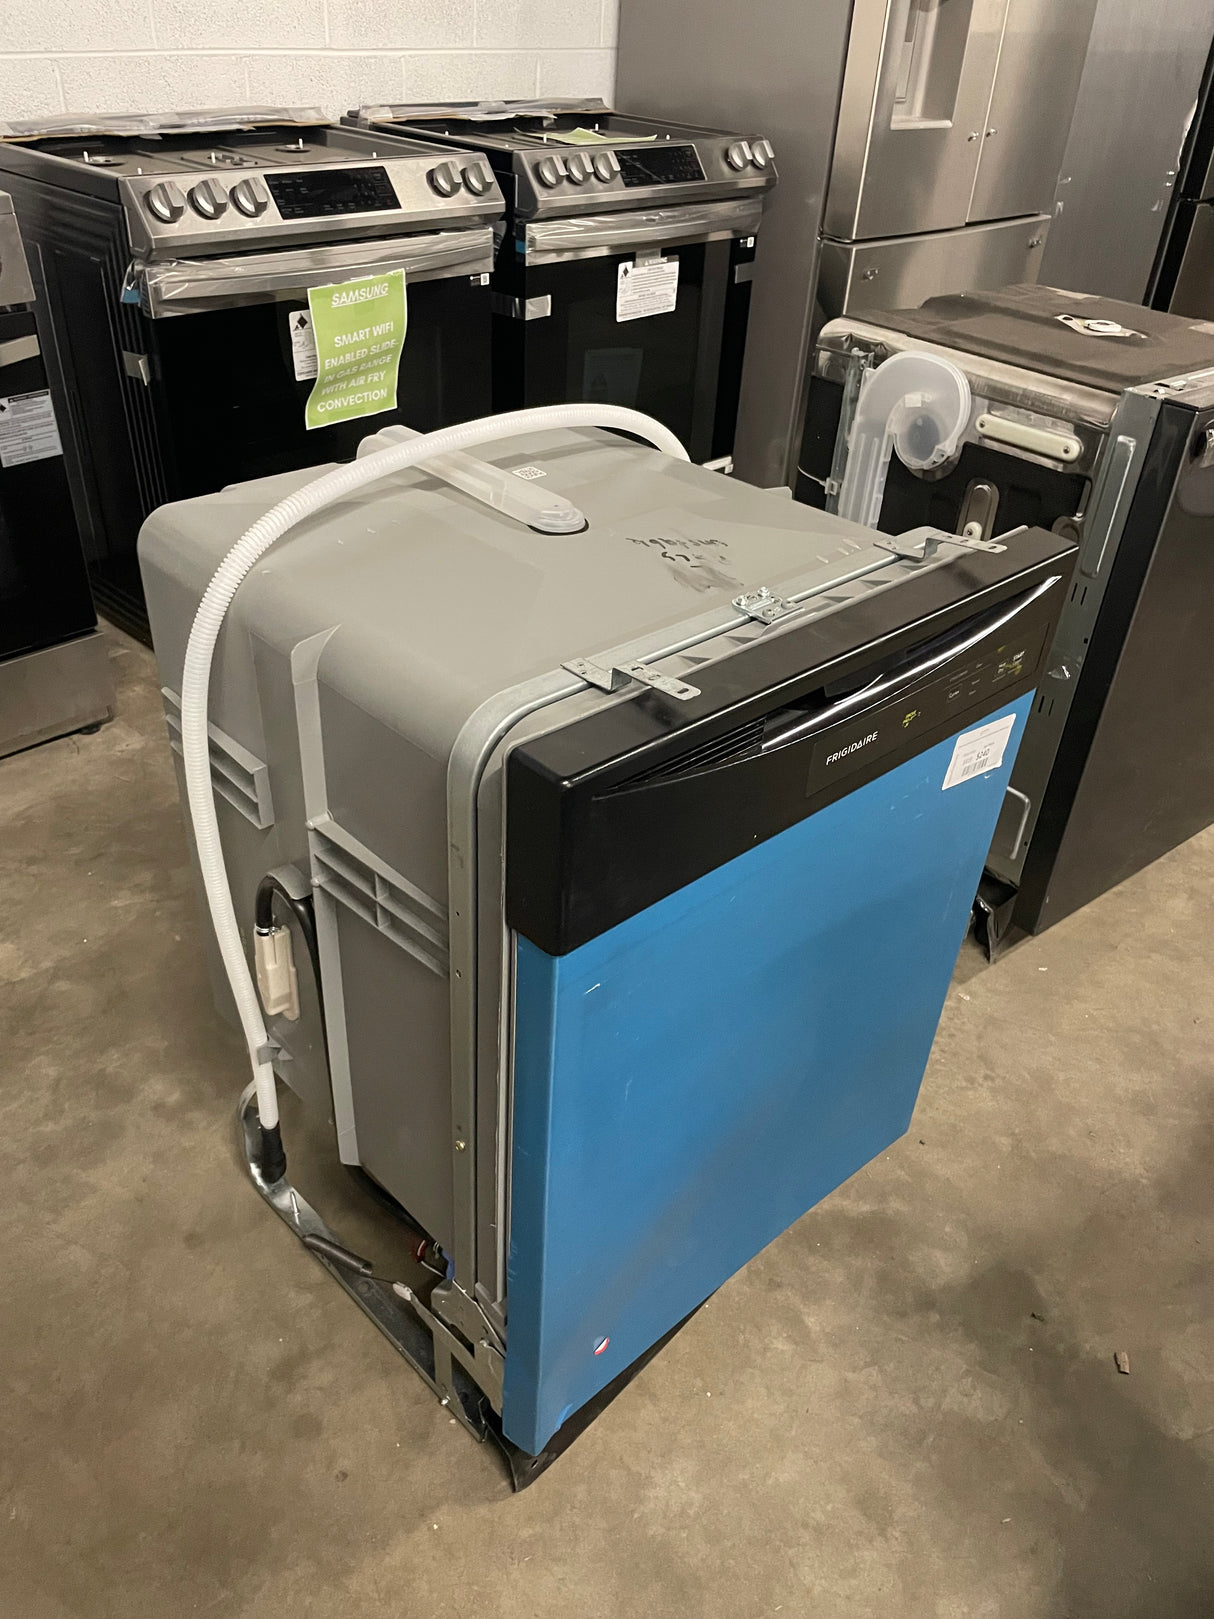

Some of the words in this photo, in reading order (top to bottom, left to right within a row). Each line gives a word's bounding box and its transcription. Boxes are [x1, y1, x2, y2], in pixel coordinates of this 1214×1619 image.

[331, 283, 389, 306] SAMSUNG
[334, 327, 370, 348] SMART
[372, 321, 394, 337] WIFI
[324, 348, 368, 370] ENABLED
[369, 339, 399, 355] SLIDE-
[324, 374, 335, 384] IN
[336, 365, 359, 380] GAS
[359, 354, 393, 371] RANGE
[321, 382, 346, 396] WITH
[348, 375, 366, 388] AIR
[367, 370, 387, 383] FRY
[316, 388, 388, 413] CONVECTION
[825, 730, 879, 766] FRIGIDAIRE
